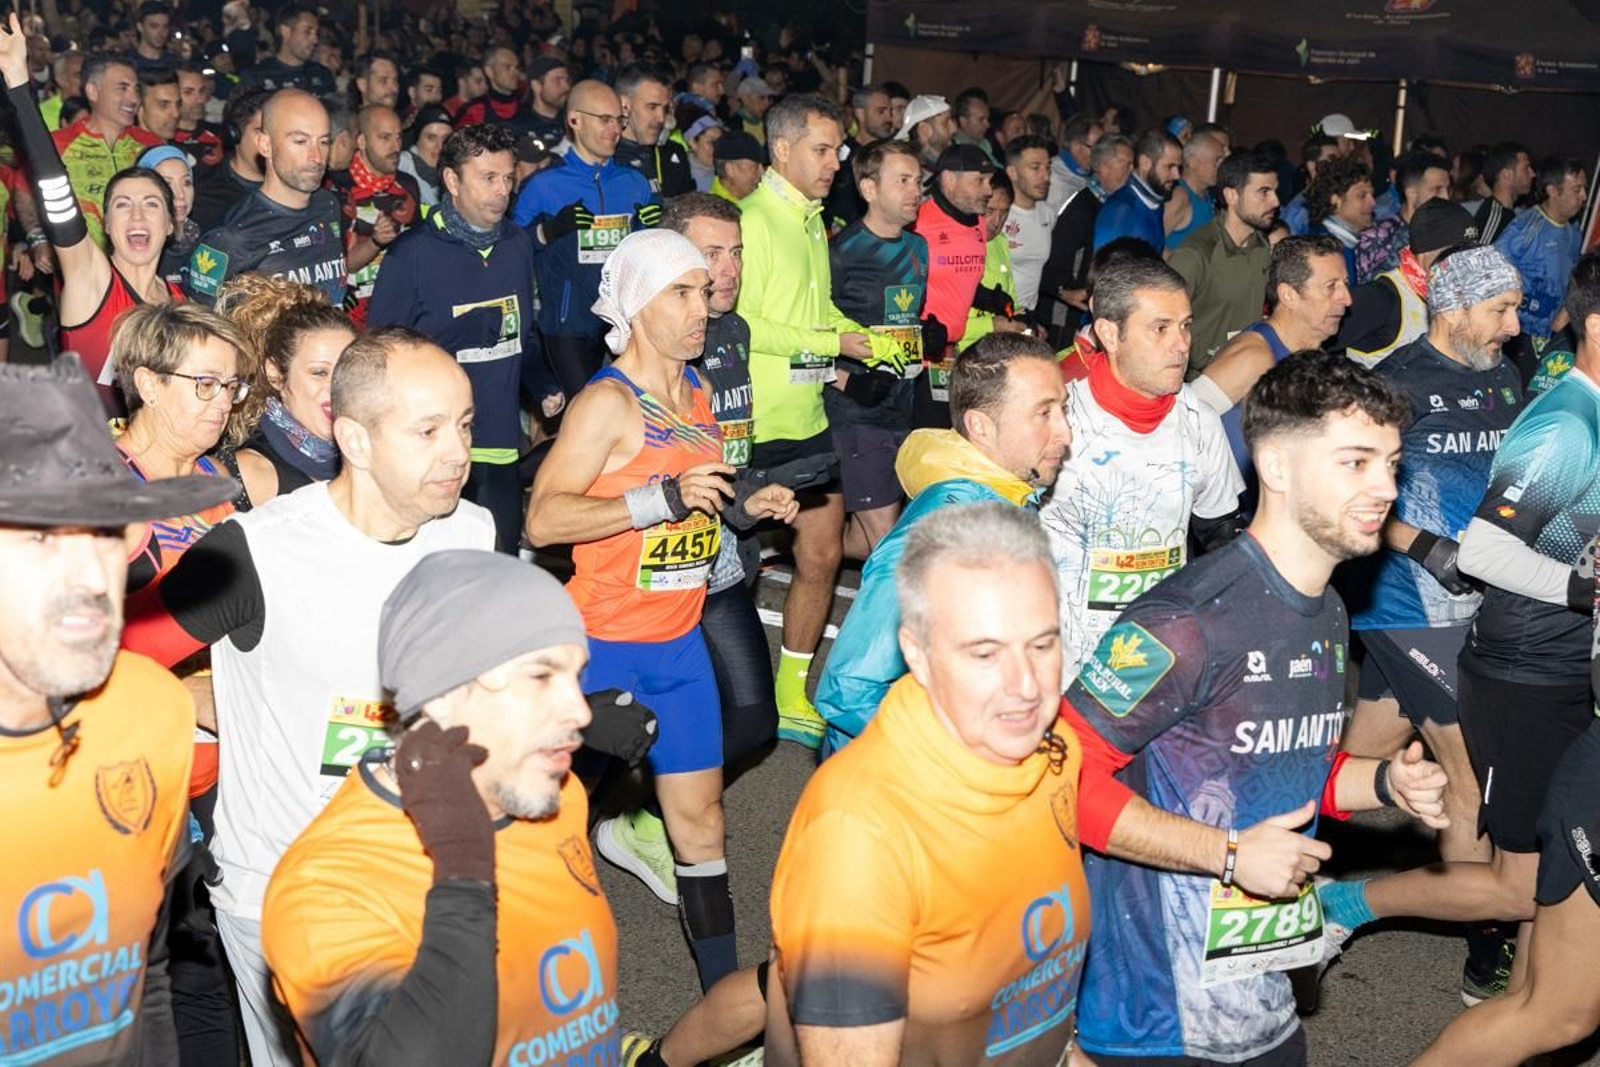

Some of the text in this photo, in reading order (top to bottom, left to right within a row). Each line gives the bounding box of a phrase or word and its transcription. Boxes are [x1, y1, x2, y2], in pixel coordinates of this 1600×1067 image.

[1426, 432, 1471, 453] SAN
[648, 527, 717, 562] 4457
[1115, 554, 1136, 569] 42
[1230, 702, 1345, 754] SAN ANTÓ
[1215, 893, 1318, 948] 2789
[0, 942, 142, 1011] OMERCIAL
